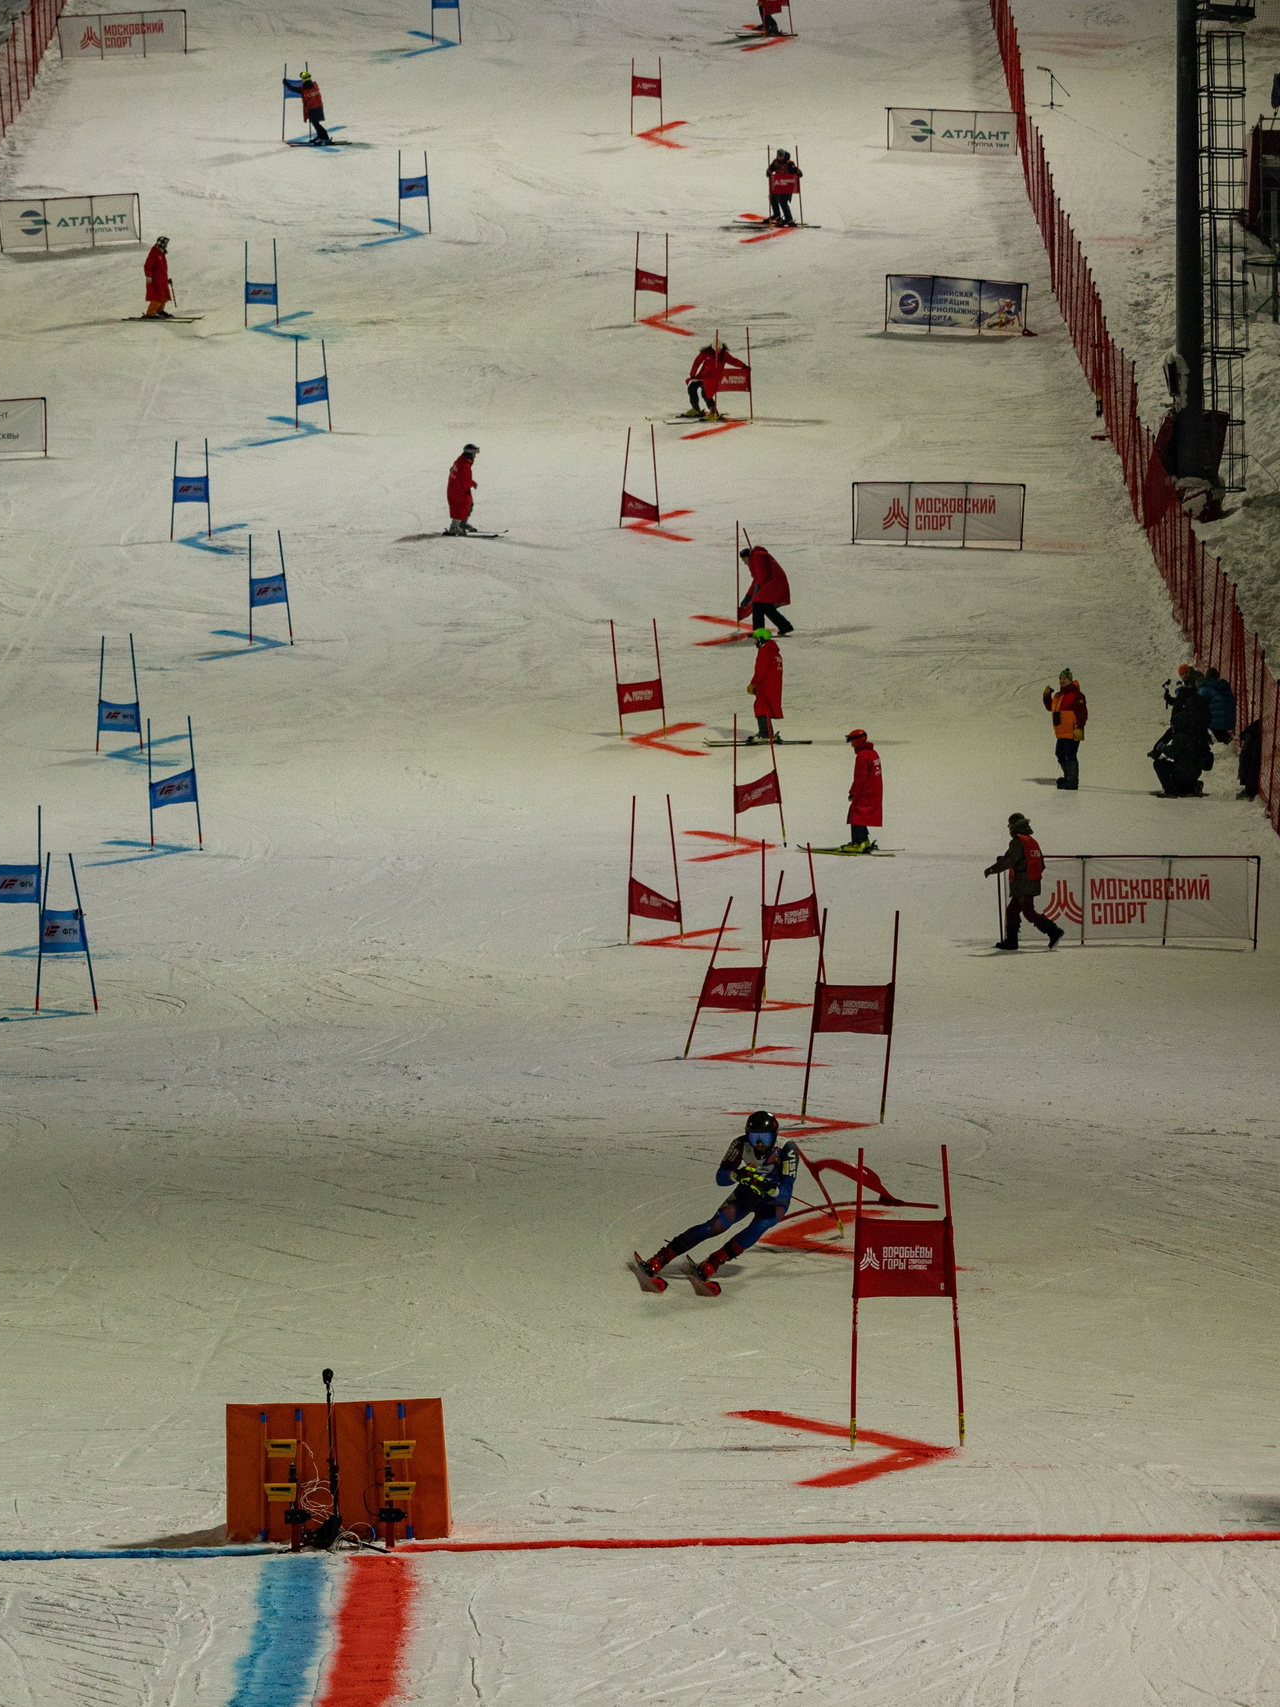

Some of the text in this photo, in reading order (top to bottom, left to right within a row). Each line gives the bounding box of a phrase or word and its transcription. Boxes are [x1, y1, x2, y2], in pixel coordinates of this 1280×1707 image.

[104, 20, 164, 36] МОСКОВСКИЙ
[105, 36, 133, 48] СПОРТ
[941, 129, 1010, 141] АТЛАНТ
[57, 214, 127, 228] АТЛАНТ
[915, 495, 996, 514] МОСКОВСКИЙ
[915, 514, 953, 530] СПОРТ
[1090, 873, 1210, 900] МОСКОВСКИЙ
[1091, 902, 1147, 925] СПОРТ
[882, 1245, 933, 1259] ВОРОБЬЁВЫ
[882, 1258, 907, 1270] ГОРЫ
